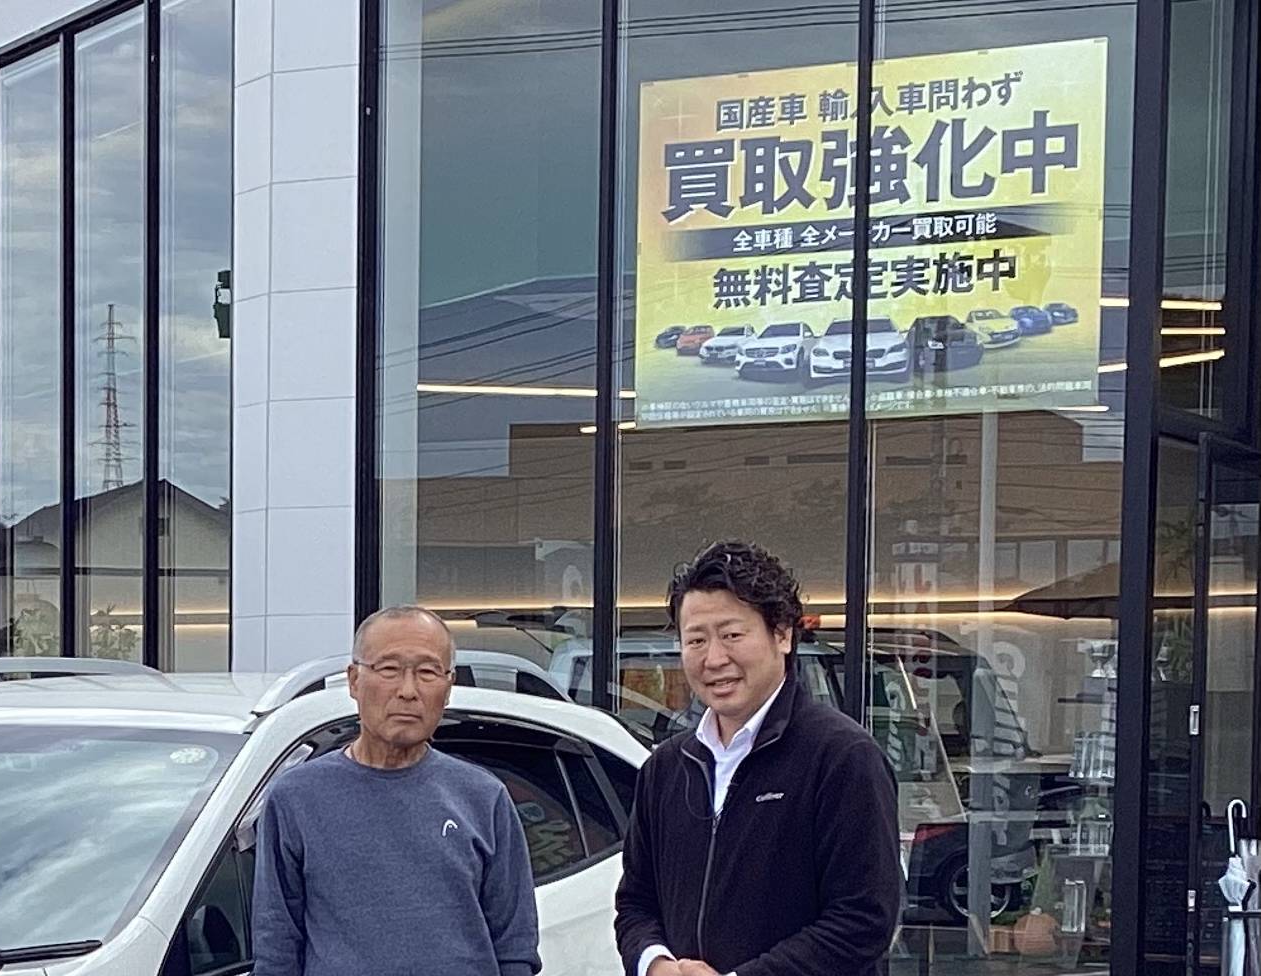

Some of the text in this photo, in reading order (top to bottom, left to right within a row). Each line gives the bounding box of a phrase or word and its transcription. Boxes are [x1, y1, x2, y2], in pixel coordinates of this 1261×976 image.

[716, 70, 1023, 131] 国産車 輸入車問わず
[661, 110, 1079, 223] 買取強化中
[732, 212, 998, 253] 全車種 全メーカー買取可能
[712, 248, 1017, 310] 無料査定実施中
